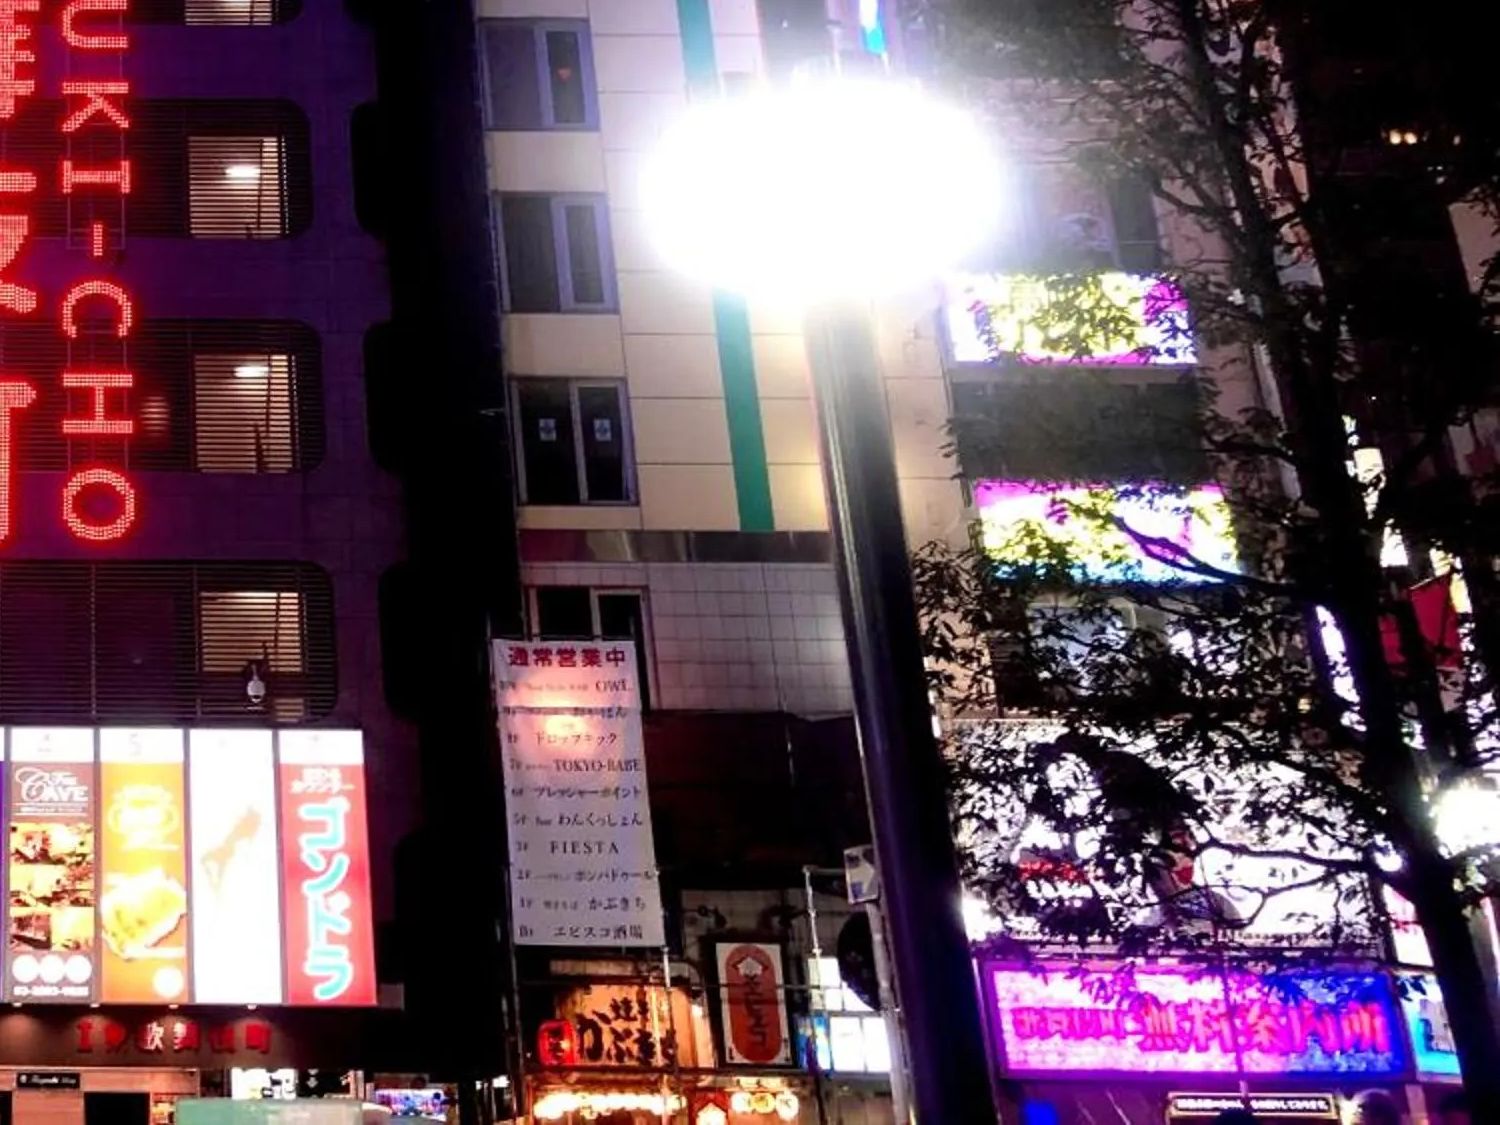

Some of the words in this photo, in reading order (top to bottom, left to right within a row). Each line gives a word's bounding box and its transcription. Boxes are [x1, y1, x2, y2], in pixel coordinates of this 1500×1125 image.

[508, 646, 626, 668] 通常営業中
[549, 840, 620, 855] FIESTA
